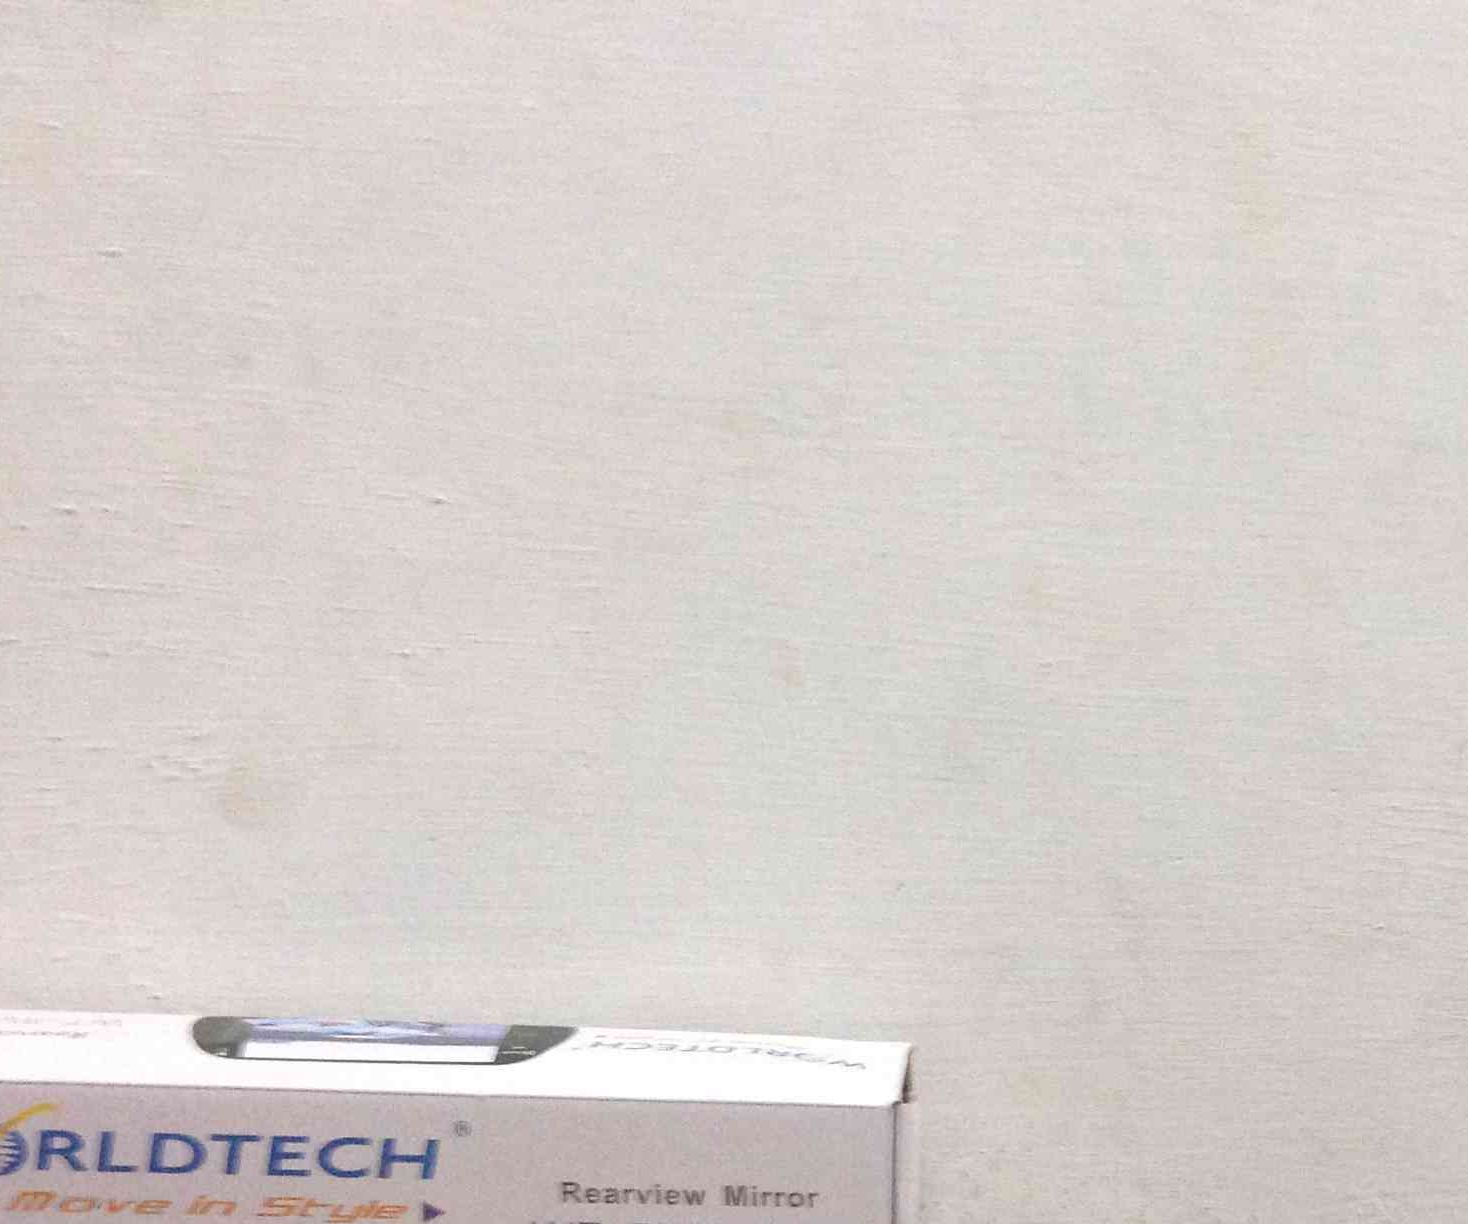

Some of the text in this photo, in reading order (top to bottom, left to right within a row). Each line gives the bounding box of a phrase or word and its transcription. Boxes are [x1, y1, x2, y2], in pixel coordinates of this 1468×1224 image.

[0, 1128, 441, 1180] ORLDTECH
[8, 1190, 410, 1224] Move in Style
[561, 1181, 820, 1208] Rearview Mirror
